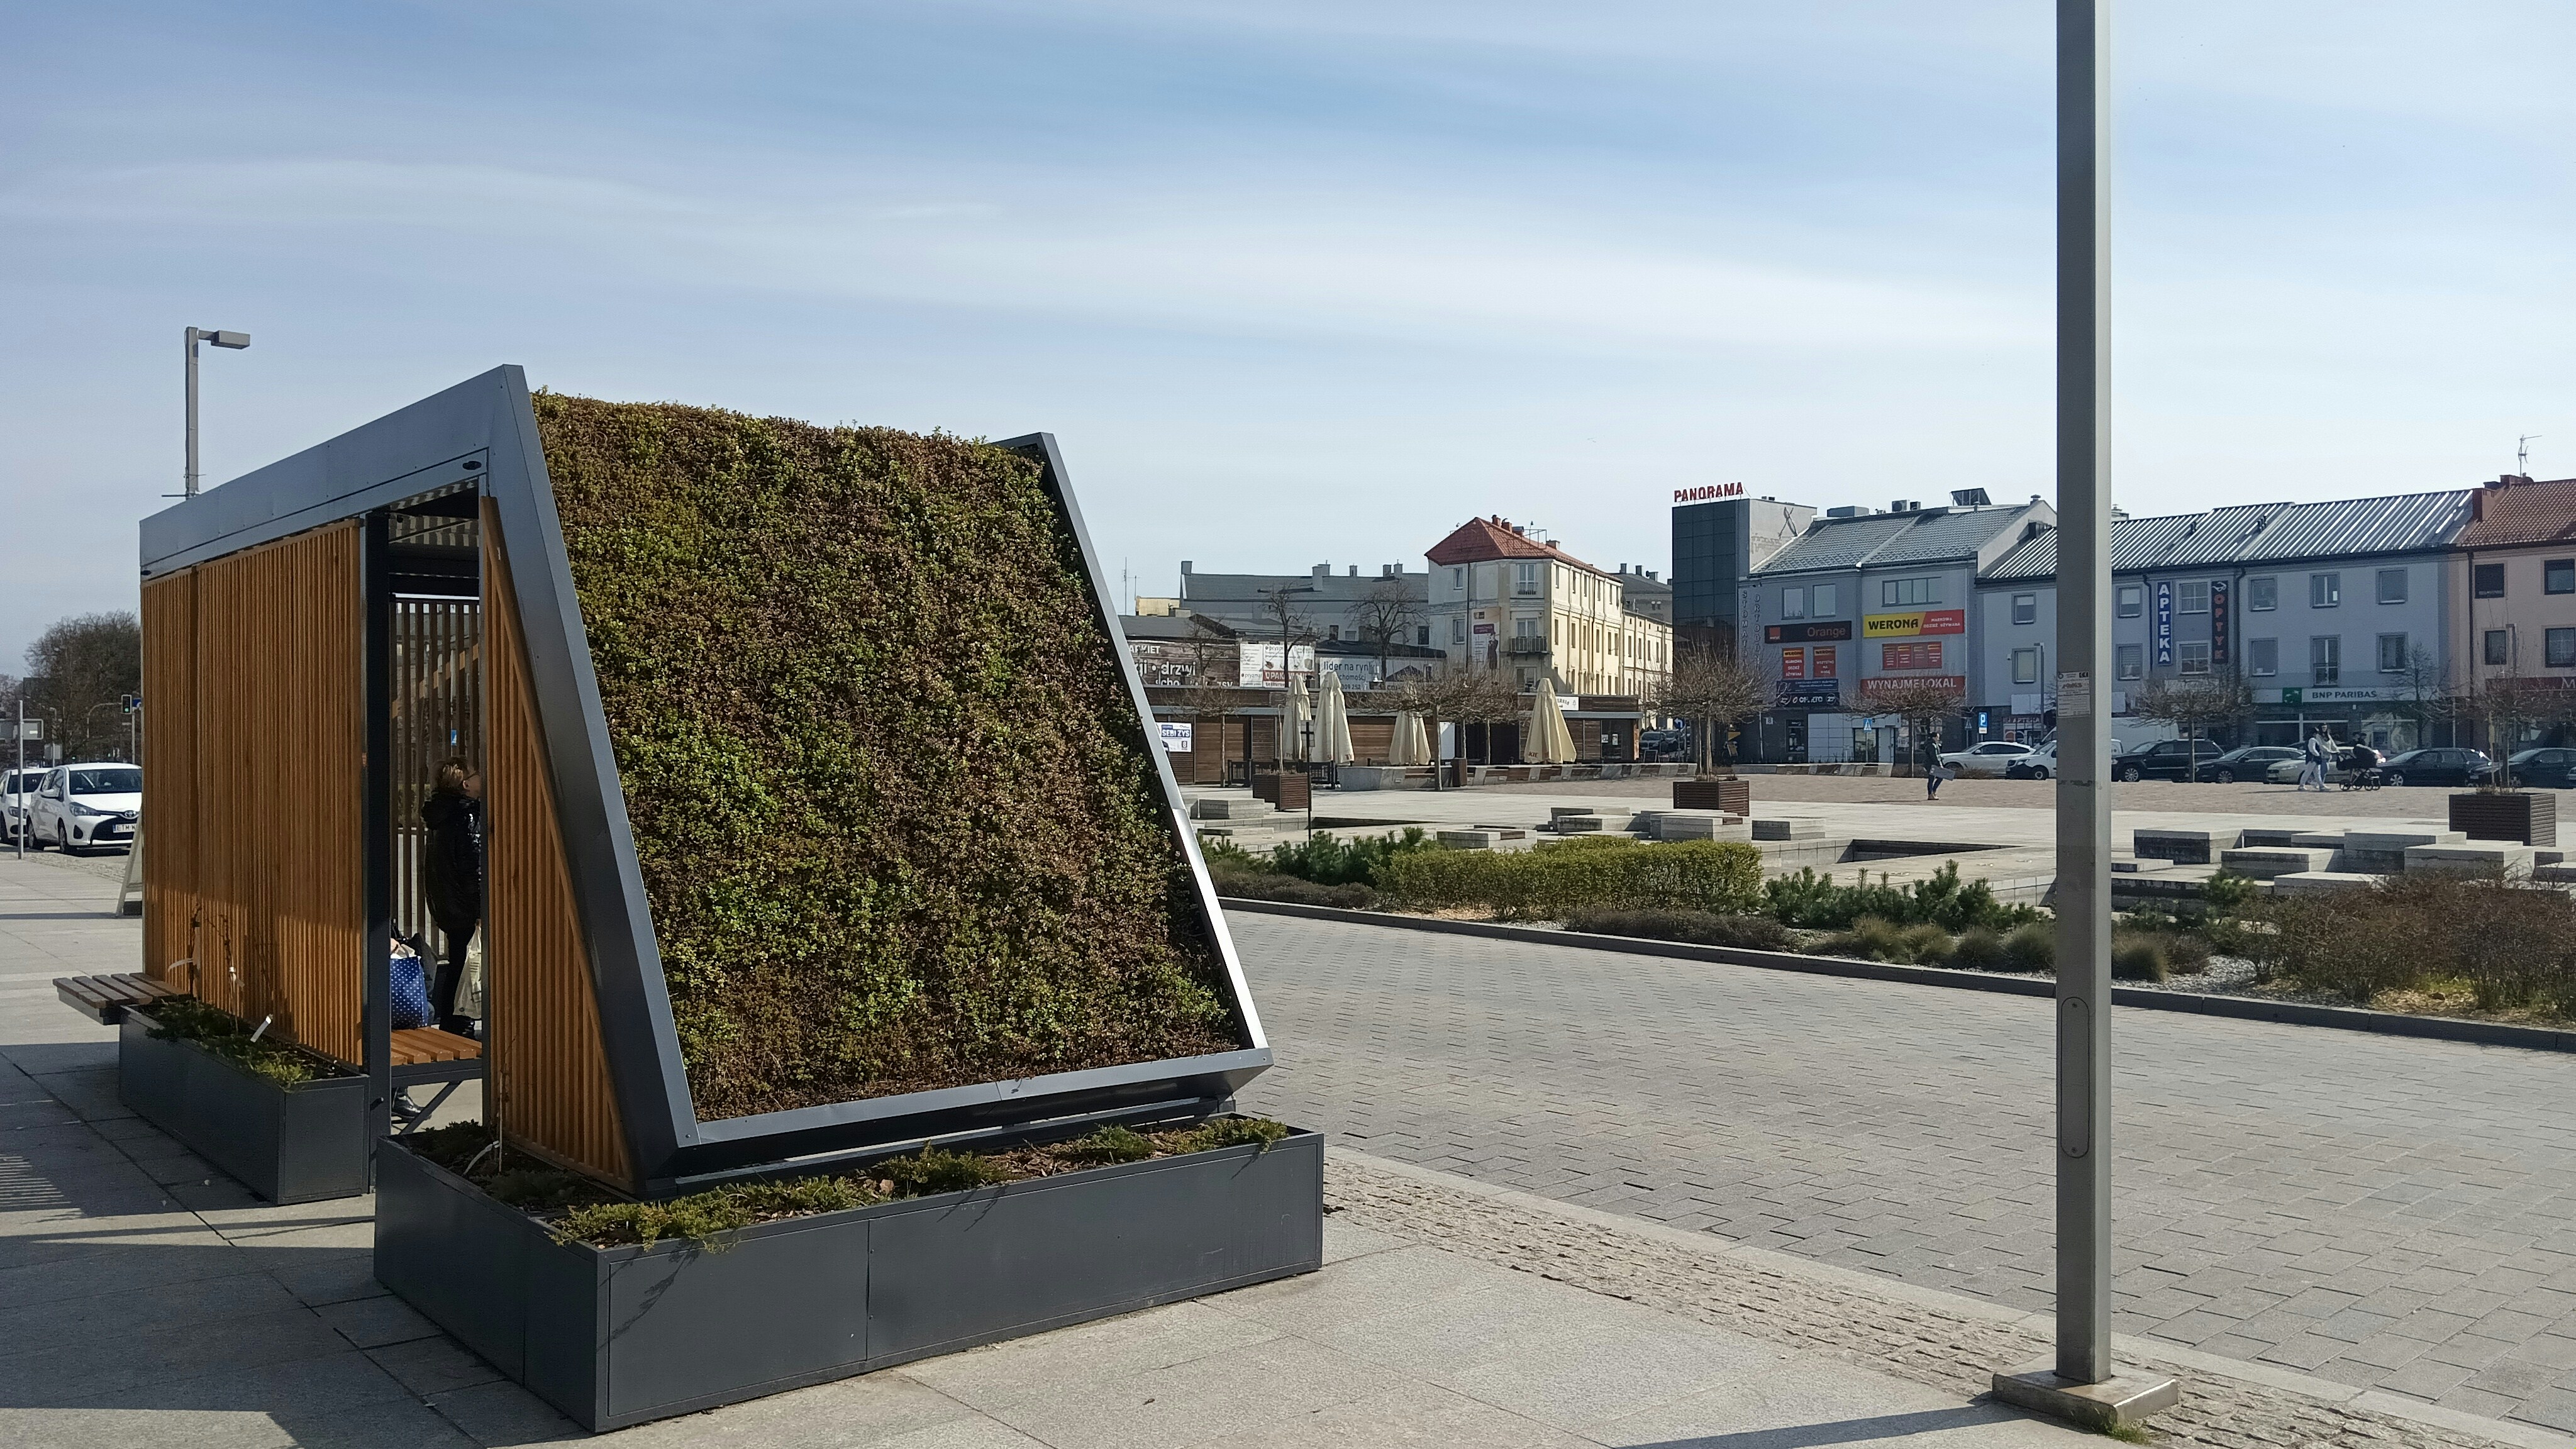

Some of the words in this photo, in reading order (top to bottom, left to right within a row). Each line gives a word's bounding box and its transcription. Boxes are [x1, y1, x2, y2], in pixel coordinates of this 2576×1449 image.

[1674, 482, 1743, 502] PANORAMA
[1868, 619, 1918, 630] WERONA
[2158, 584, 2170, 662] APTEKA
[2214, 594, 2224, 660] OPTYK
[1807, 627, 1845, 638] Orange
[1324, 662, 1342, 670] lider
[1339, 674, 1366, 682] chomości
